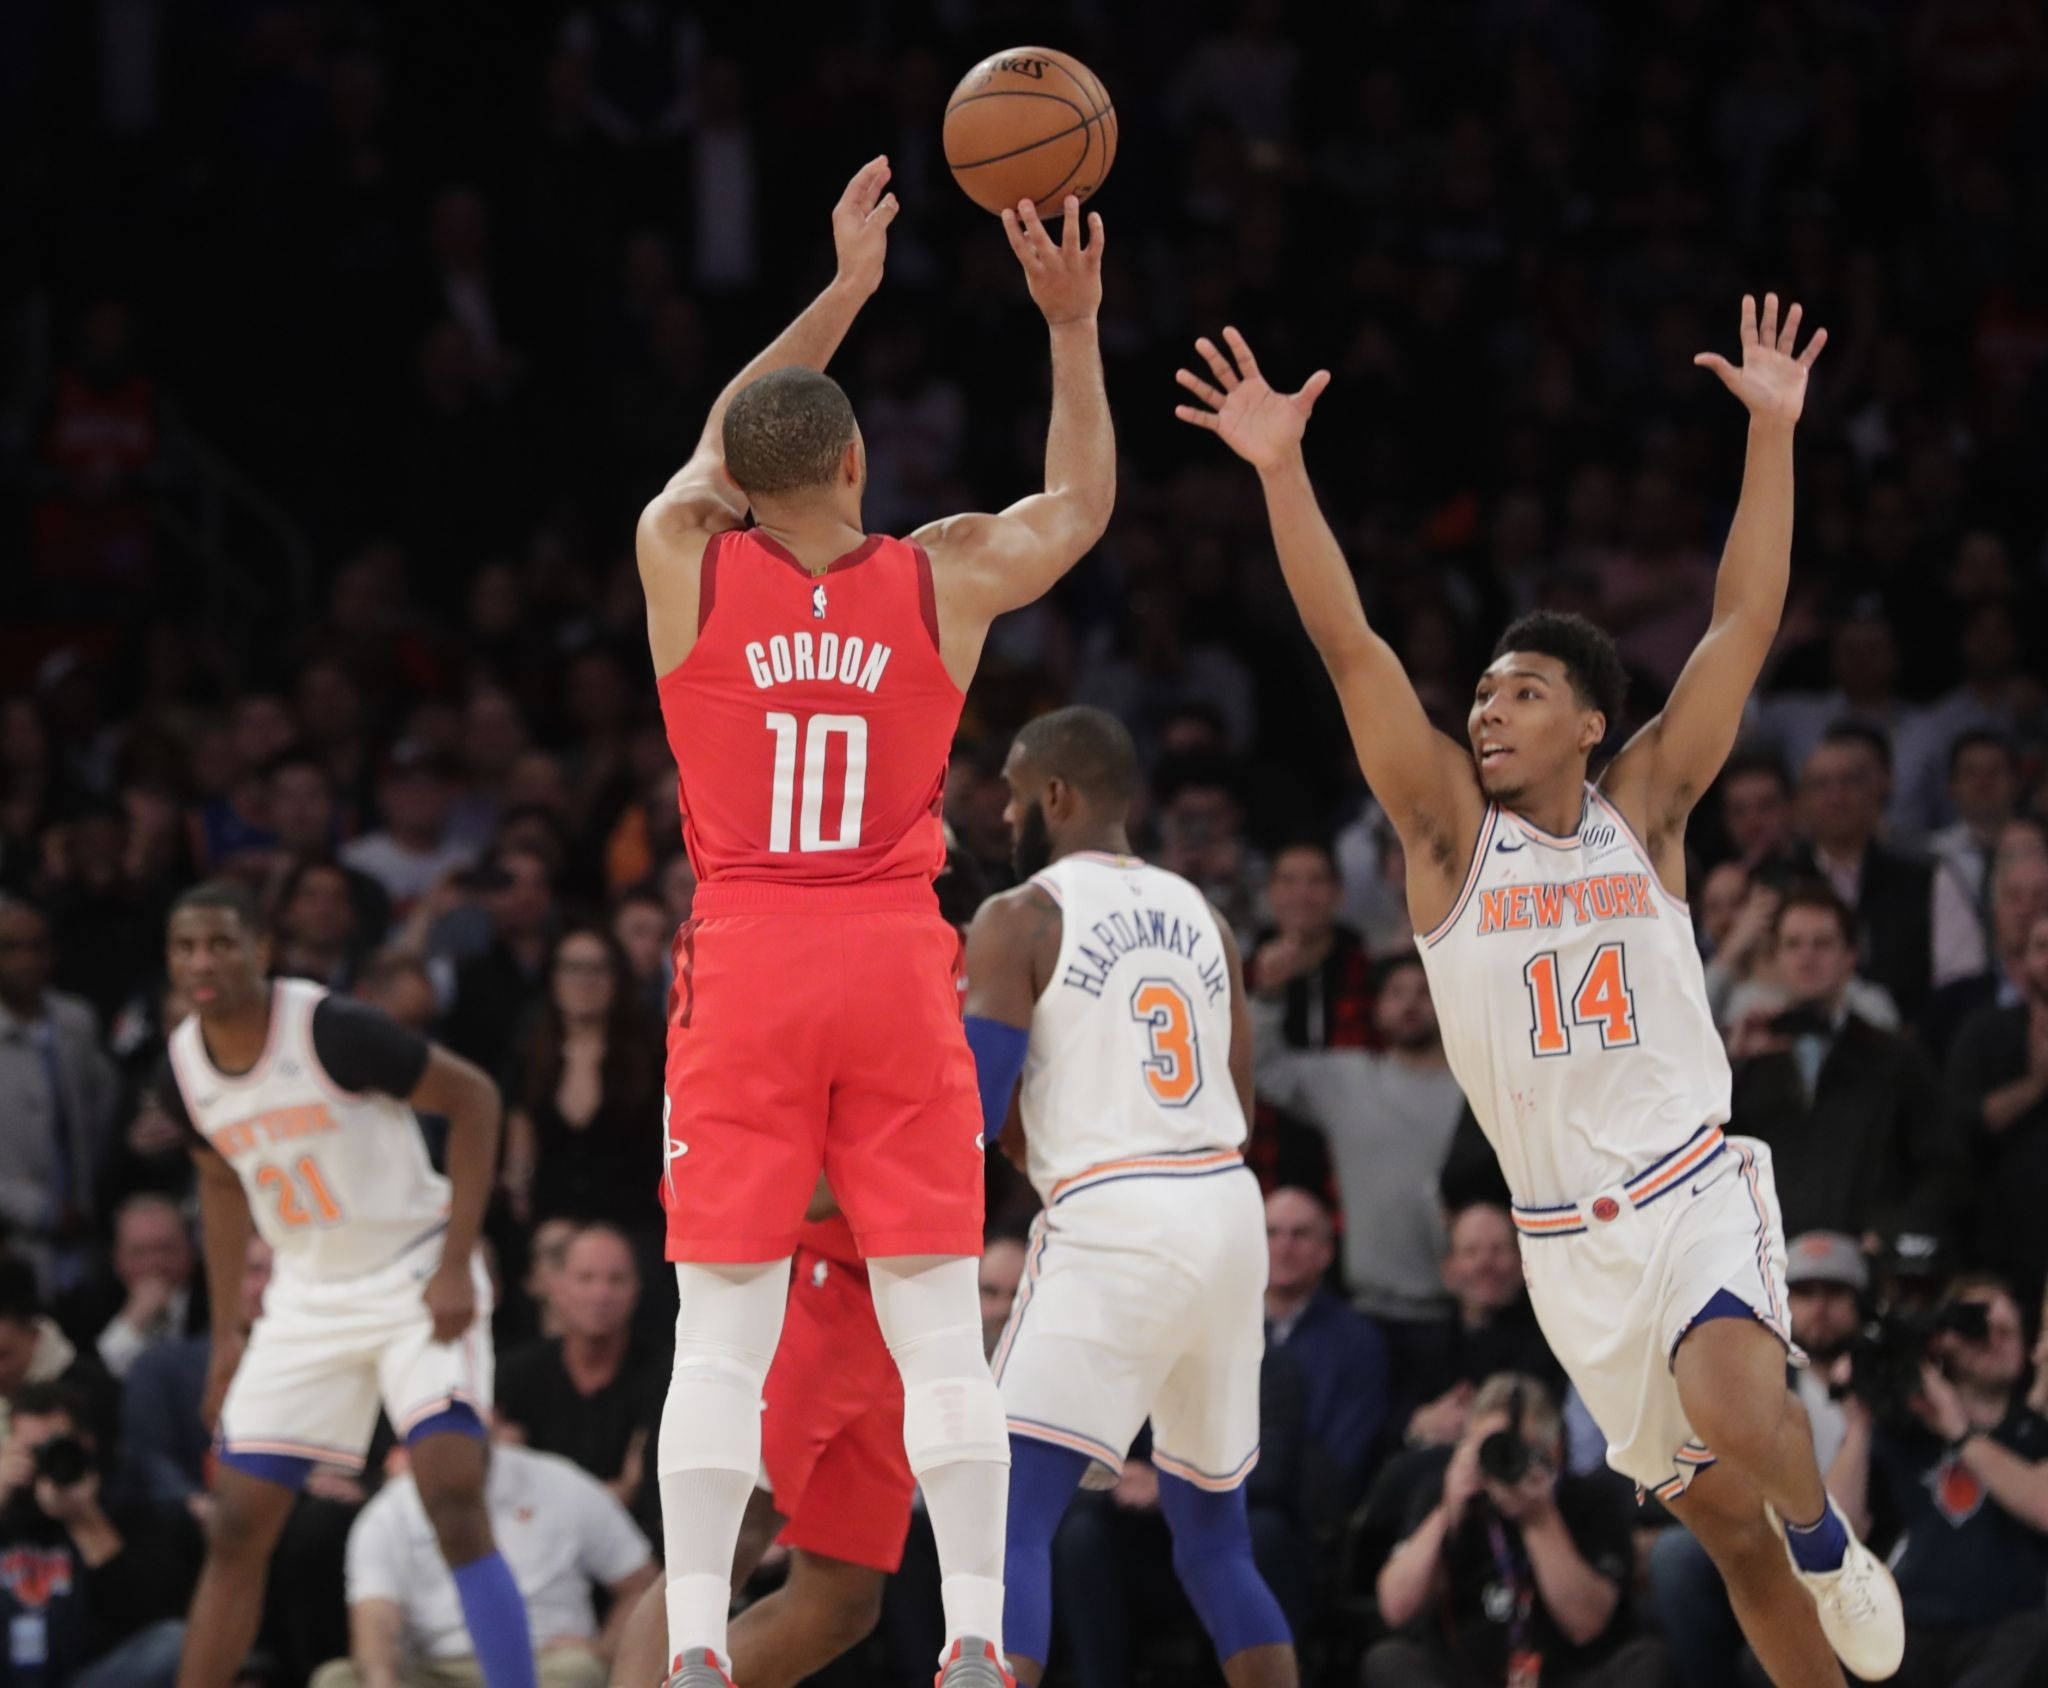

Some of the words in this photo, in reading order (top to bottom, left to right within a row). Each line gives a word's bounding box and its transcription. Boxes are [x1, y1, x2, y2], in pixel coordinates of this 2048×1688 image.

[745, 631, 892, 694] GORDON
[766, 711, 868, 853] 10
[1063, 909, 1201, 998] HARDAWAY
[1523, 942, 1640, 1058] 14
[1130, 977, 1203, 1108] 3
[255, 1154, 345, 1228] 21
